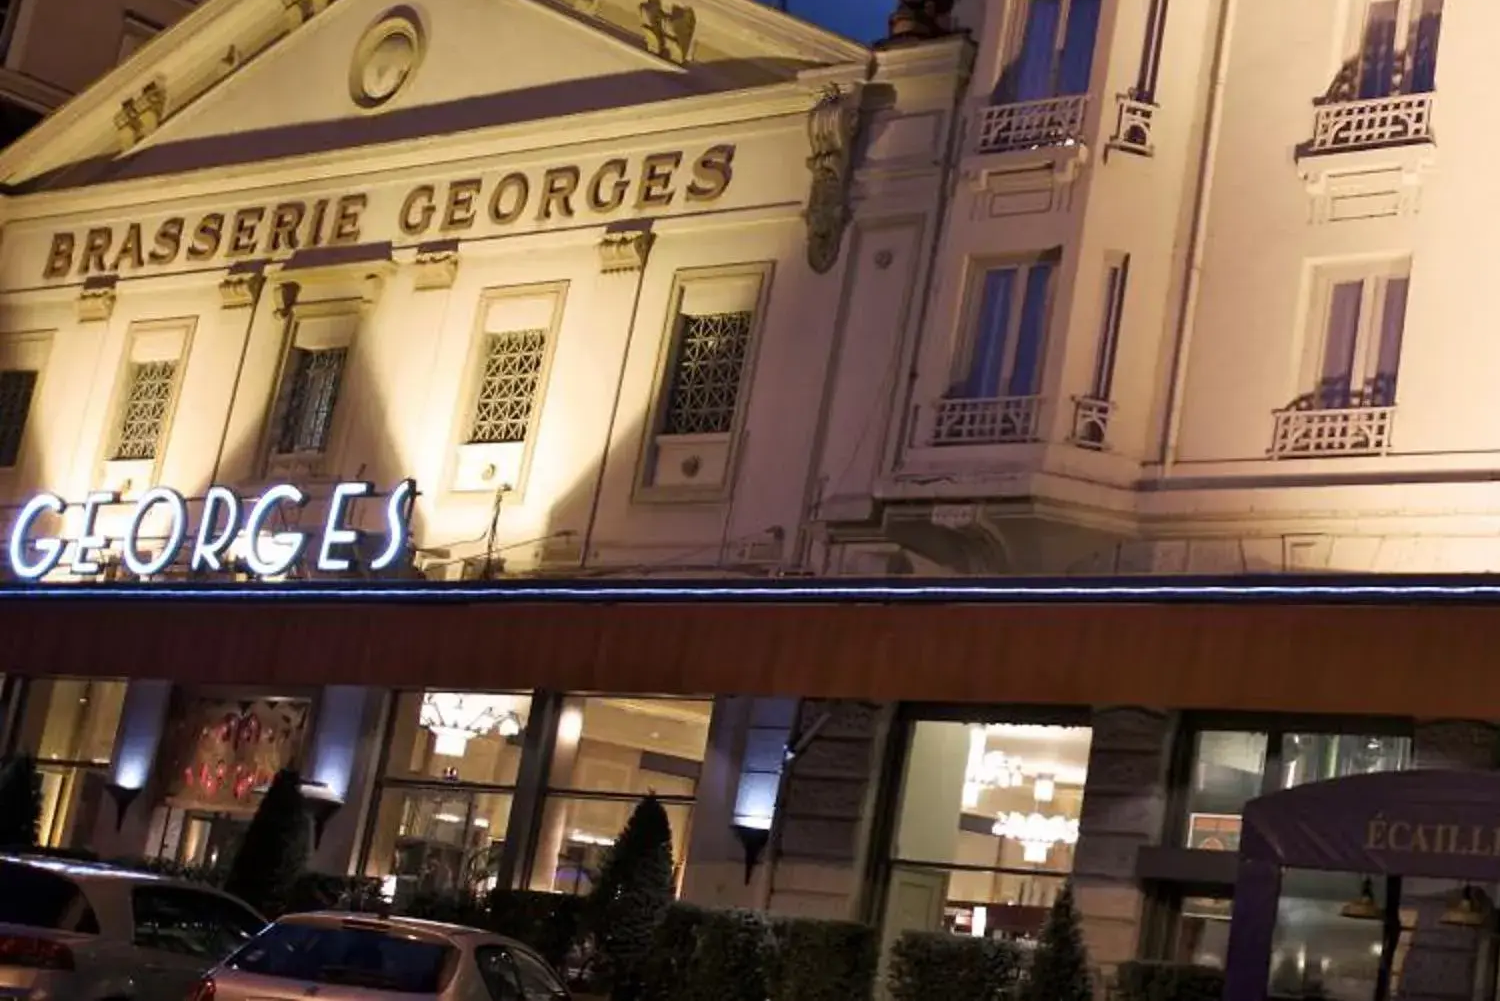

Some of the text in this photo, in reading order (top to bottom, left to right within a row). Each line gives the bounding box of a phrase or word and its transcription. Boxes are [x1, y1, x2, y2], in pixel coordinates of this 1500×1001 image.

[41, 143, 737, 280] BRASSERIE GEORGES
[9, 478, 416, 580] GEORGES
